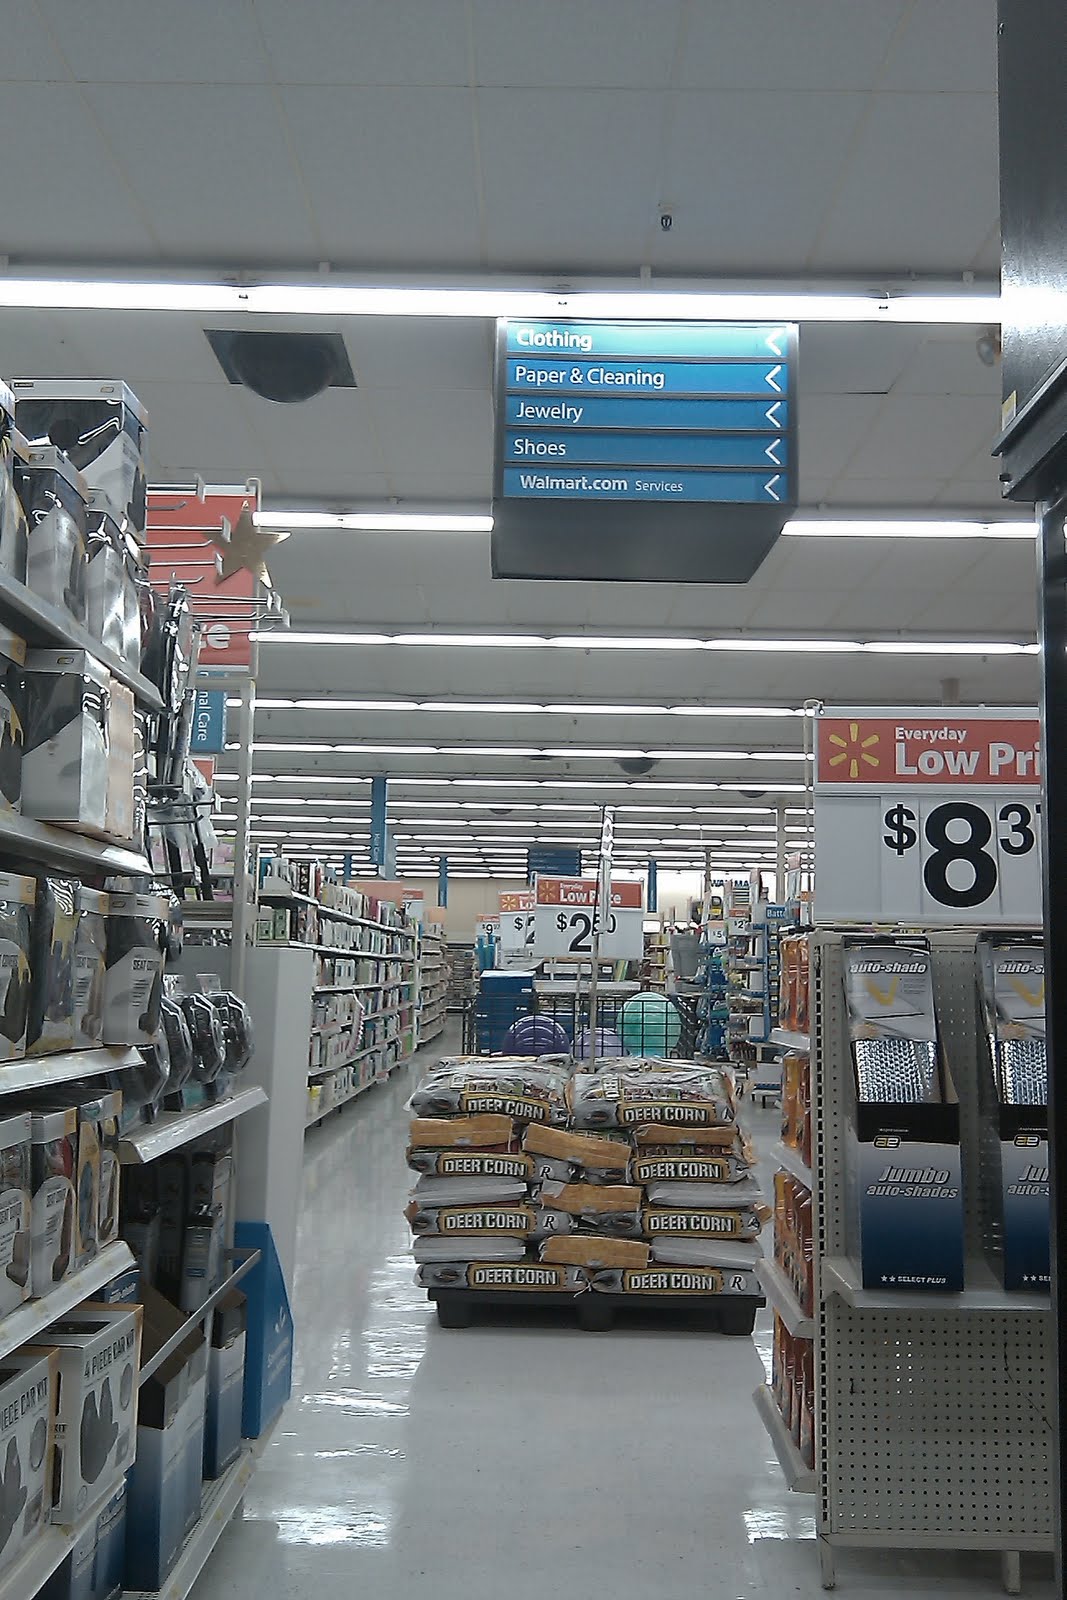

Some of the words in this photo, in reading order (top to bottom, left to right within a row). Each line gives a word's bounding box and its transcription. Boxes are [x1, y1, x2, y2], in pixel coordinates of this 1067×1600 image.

[516, 328, 593, 352] Clothing
[515, 366, 566, 387] Paper
[570, 368, 583, 385] &
[586, 368, 665, 390] Cleaning
[516, 402, 583, 423] Jewelry
[513, 438, 566, 456] Shoes
[519, 474, 628, 491] Walmart.com
[635, 479, 683, 492] Services
[197, 712, 211, 741] Care
[895, 727, 967, 743] Everyday
[895, 742, 980, 776] Low
[560, 889, 587, 903] Low
[467, 1099, 503, 1112] DEER
[505, 1102, 544, 1120] CORN
[625, 1106, 661, 1122] DEER
[664, 1106, 706, 1122] CORN
[444, 1159, 481, 1173] DEER
[484, 1160, 525, 1176] CORN
[640, 1163, 675, 1179] DEER
[678, 1162, 719, 1179] CORN
[866, 1184, 959, 1199] auto-shades
[446, 1213, 483, 1229] DEER
[486, 1213, 527, 1229] CORN
[650, 1215, 687, 1231] DEER
[690, 1215, 732, 1232] CORN
[475, 1268, 513, 1284] DEER
[515, 1268, 556, 1285] CORN
[631, 1273, 668, 1289] DEER
[670, 1273, 713, 1290] CORN
[897, 1275, 925, 1284] SELECT
[926, 1276, 947, 1284] PLUS
[84, 1360, 90, 1378] 4
[92, 1345, 112, 1375] PIECE
[112, 1335, 125, 1360] CAR
[126, 1328, 135, 1349] KIT
[20, 1386, 36, 1415] CAR
[36, 1376, 48, 1402] KIT
